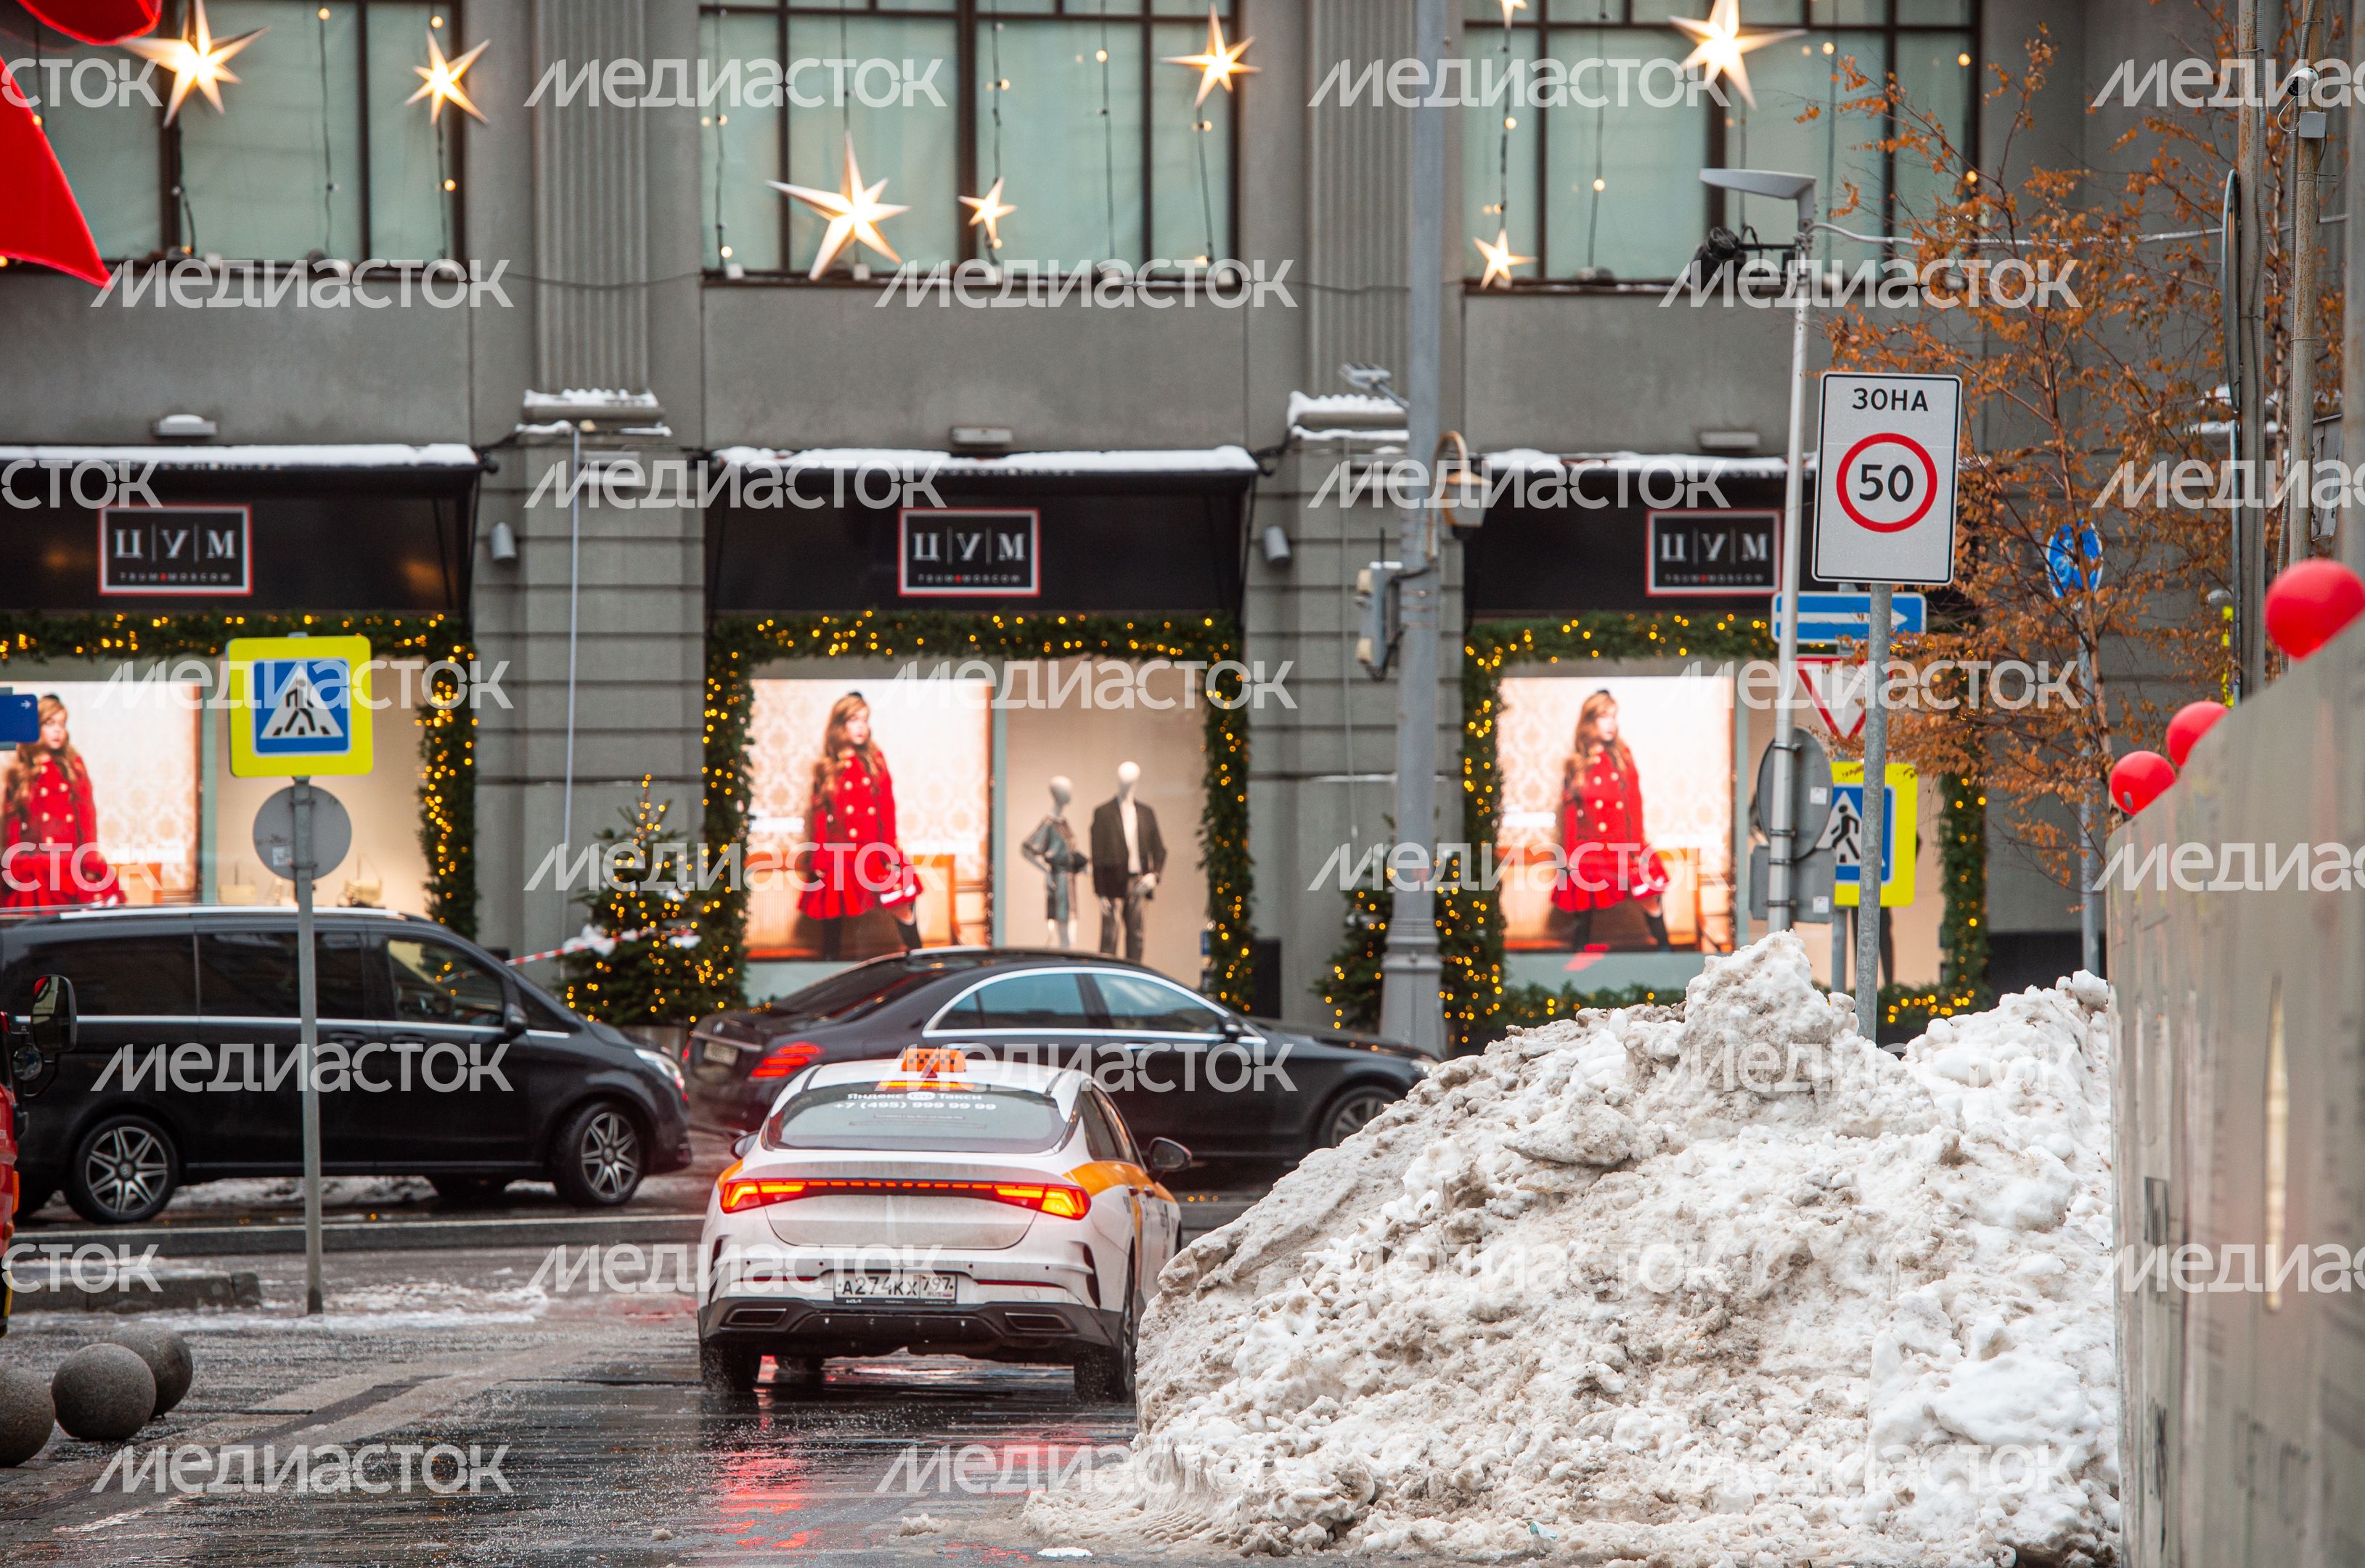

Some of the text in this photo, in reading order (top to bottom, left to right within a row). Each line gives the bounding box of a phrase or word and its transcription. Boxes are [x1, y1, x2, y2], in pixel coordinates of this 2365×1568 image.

[1853, 388, 1929, 412] ЗОНА
[1859, 464, 1914, 502] 50
[922, 1276, 952, 1291] 797
